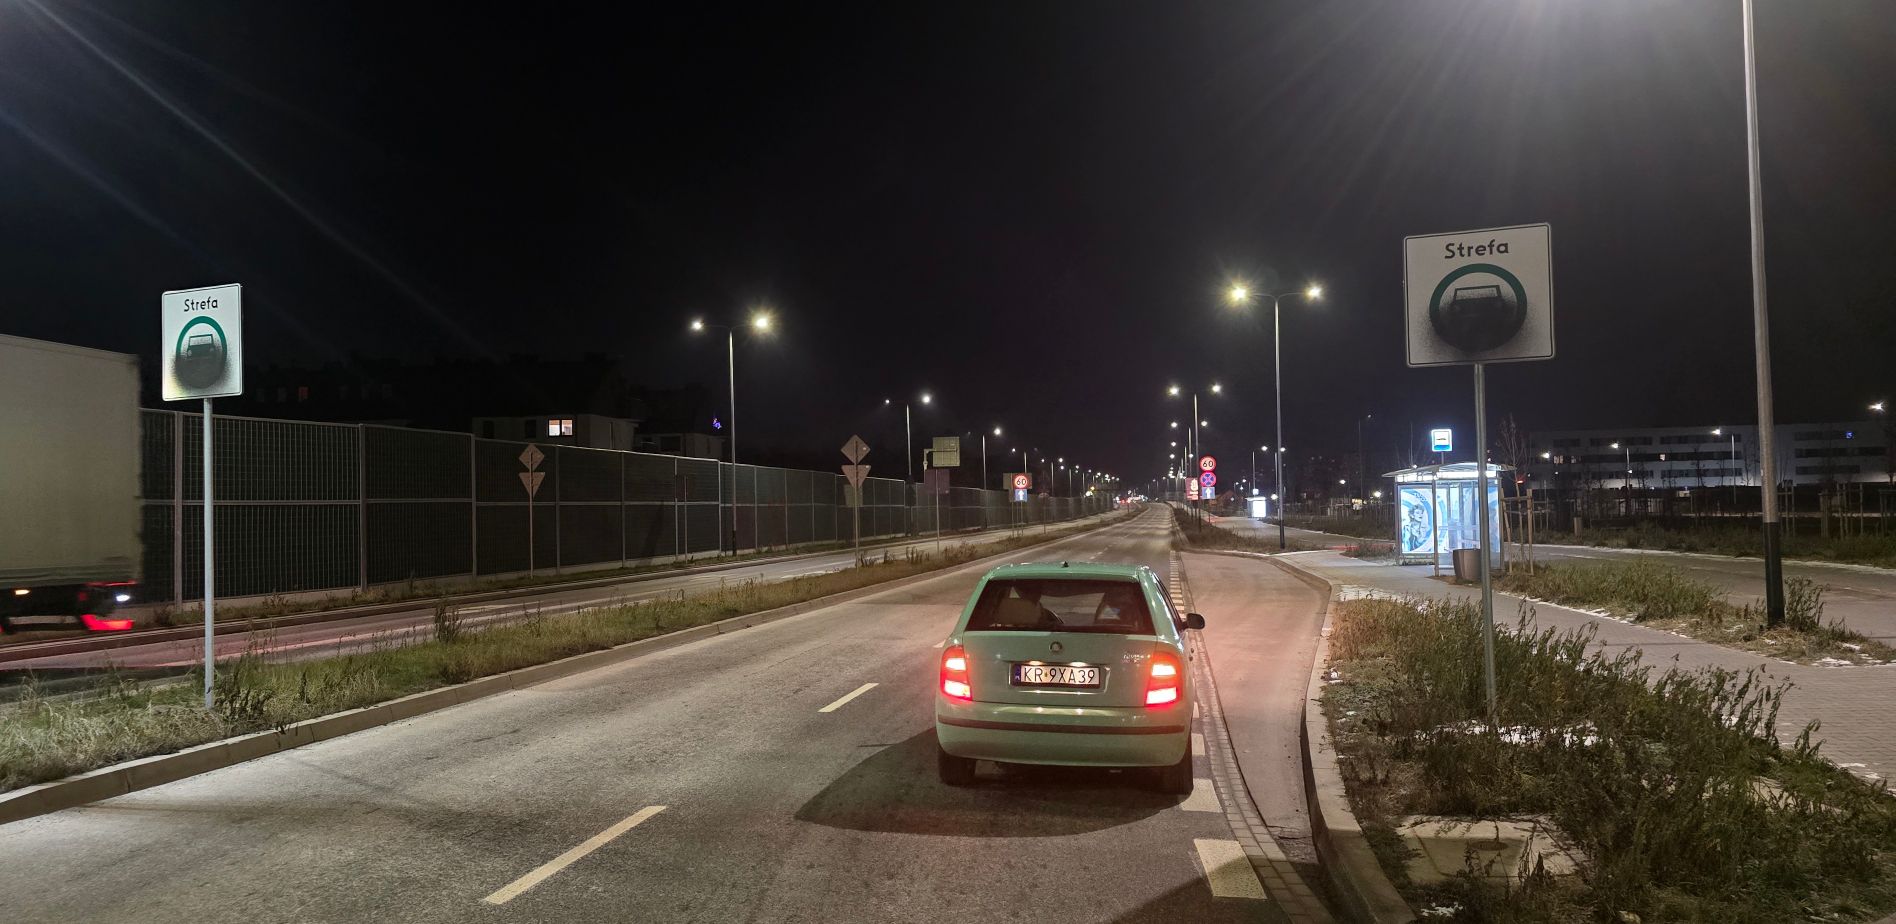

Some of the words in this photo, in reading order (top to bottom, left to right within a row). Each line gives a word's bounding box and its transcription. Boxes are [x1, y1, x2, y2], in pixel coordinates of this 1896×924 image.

[1445, 239, 1509, 259] Strefa
[184, 296, 218, 312] Strefa
[1203, 460, 1214, 468] 60
[1016, 478, 1027, 486] 60
[1024, 667, 1043, 682] KR
[1049, 668, 1095, 684] 9XA39
